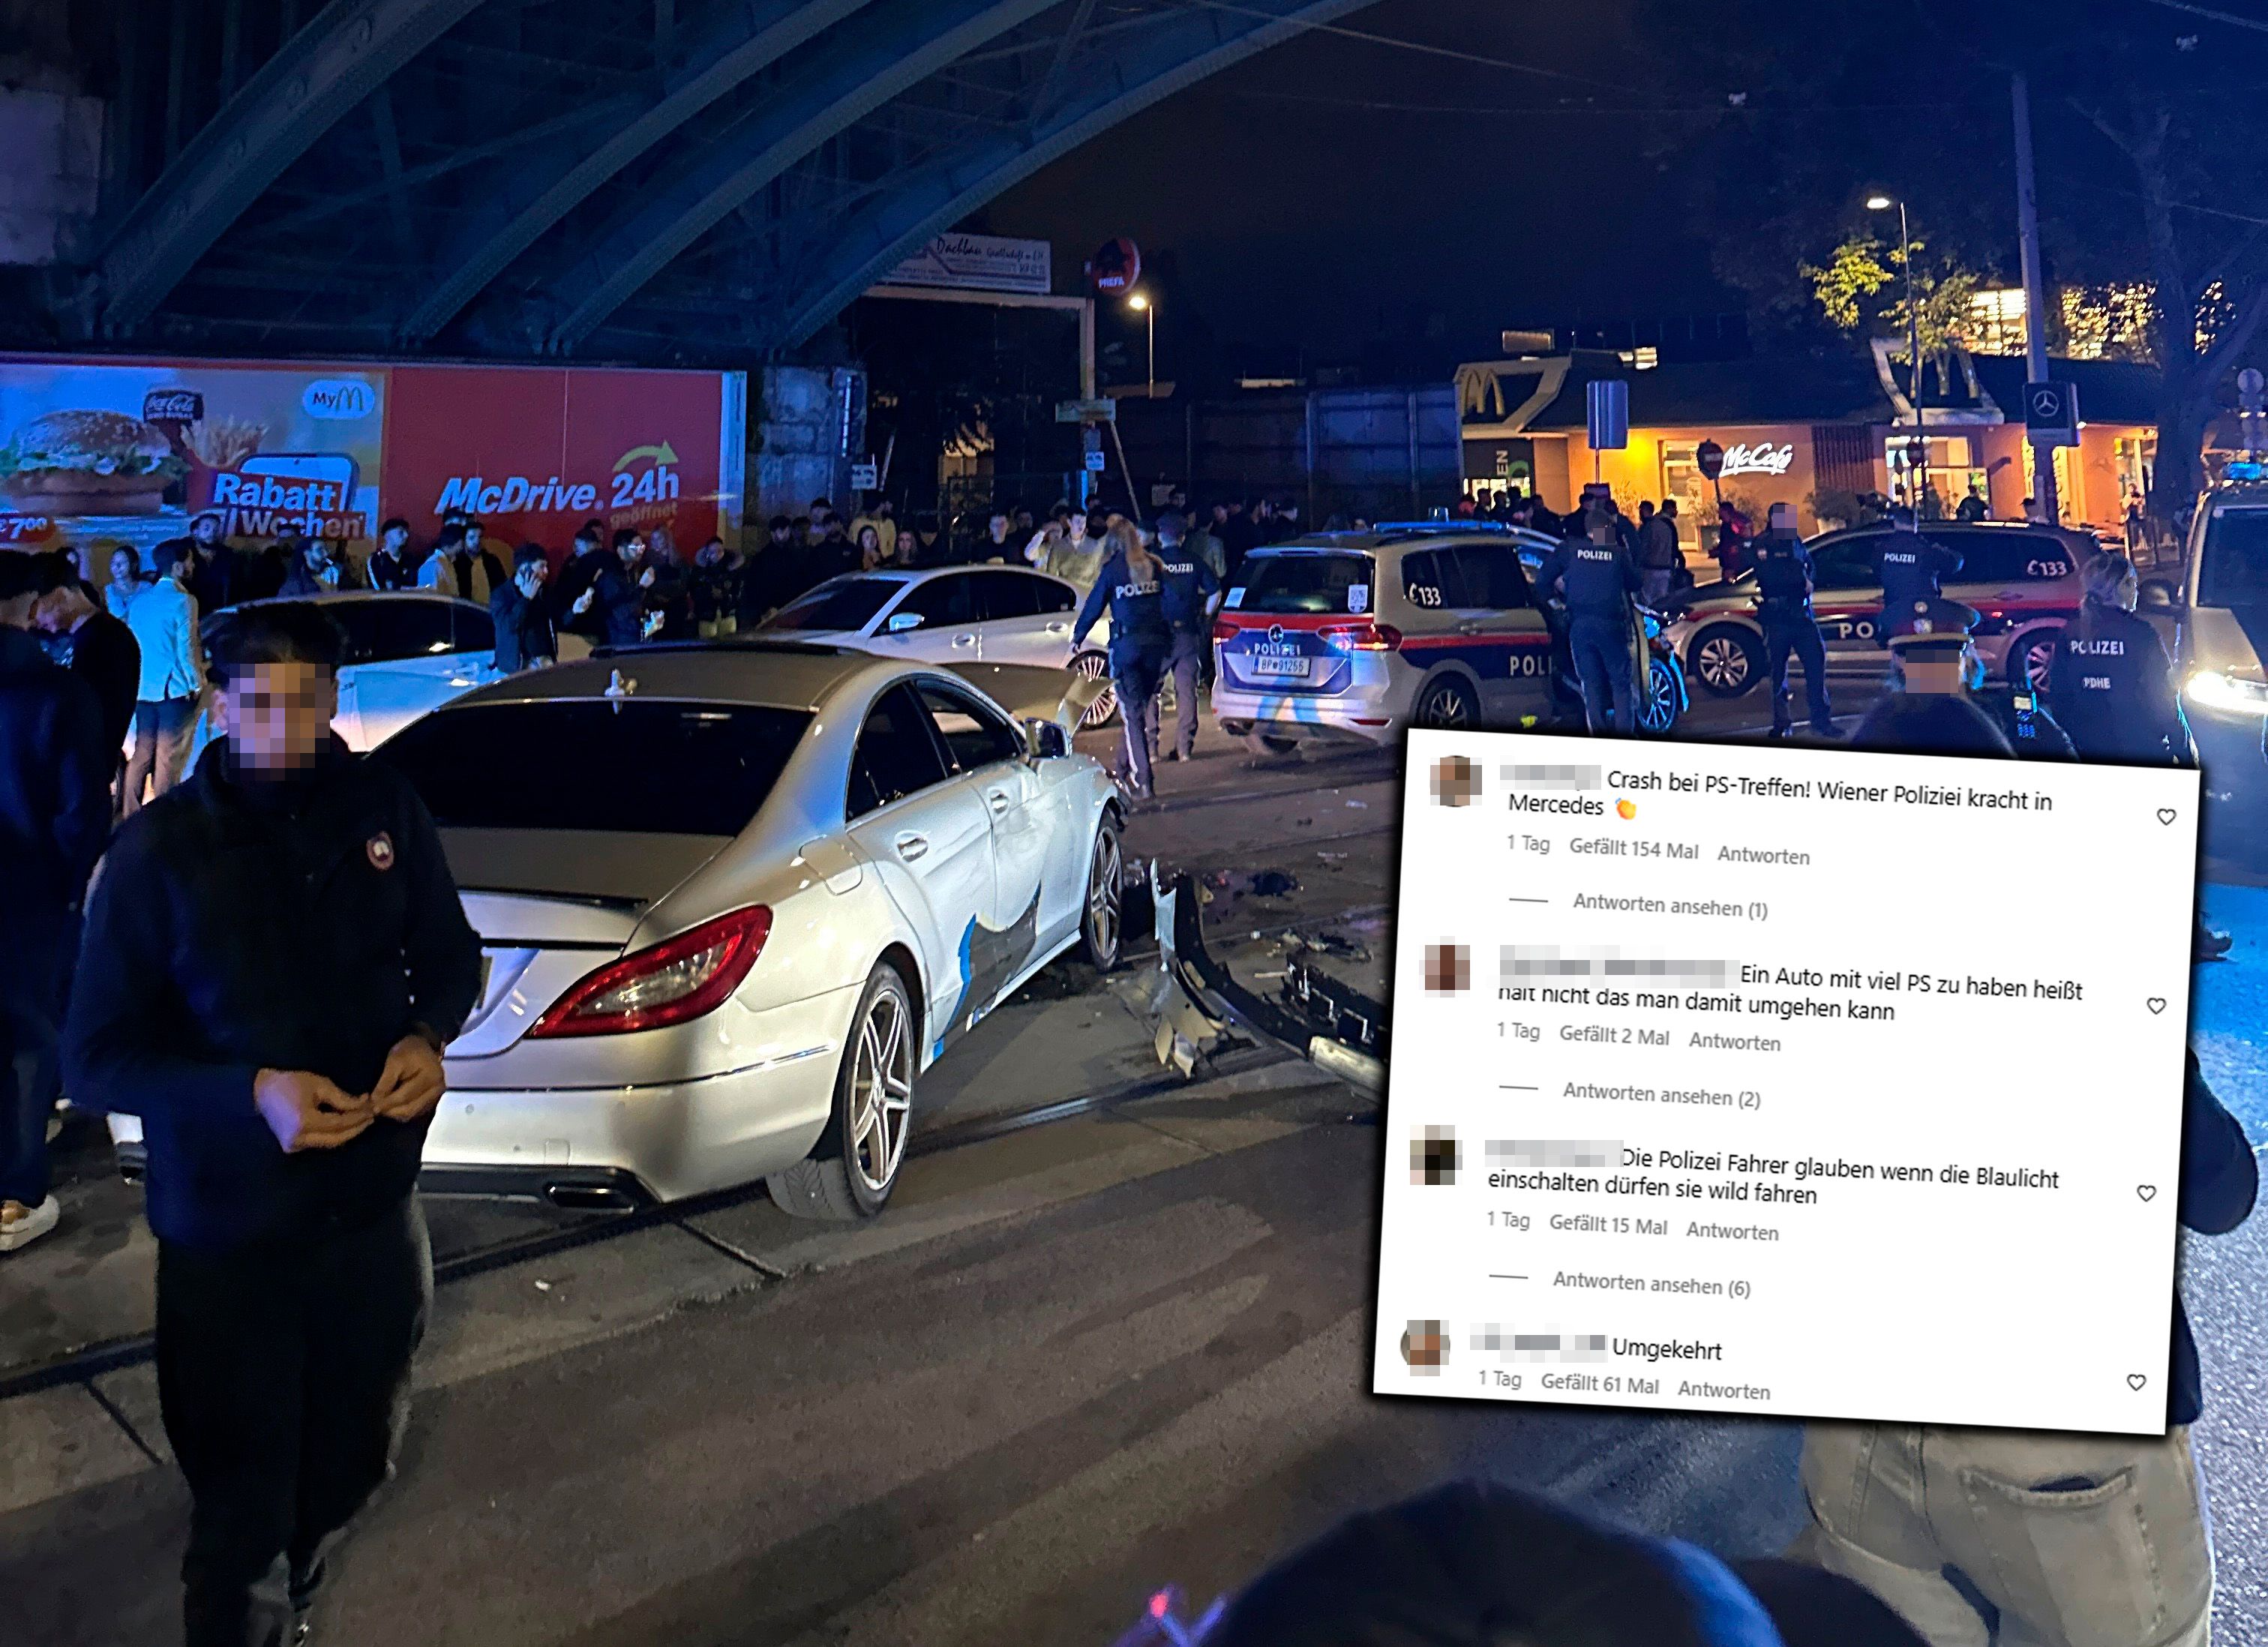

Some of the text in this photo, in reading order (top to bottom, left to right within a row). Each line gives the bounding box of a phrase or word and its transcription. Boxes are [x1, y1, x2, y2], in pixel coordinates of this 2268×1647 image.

[214, 473, 336, 512] Rabatt
[610, 466, 680, 509] 24h
[1576, 548, 1612, 561] POLIZEI
[1883, 552, 1916, 563] POLIZEI
[1115, 580, 1160, 599] POLIZE
[1839, 622, 1882, 639] PO
[1254, 643, 1301, 656] POLIZEI
[2071, 640, 2124, 656] POLIZEI
[1510, 655, 1552, 677] POLI
